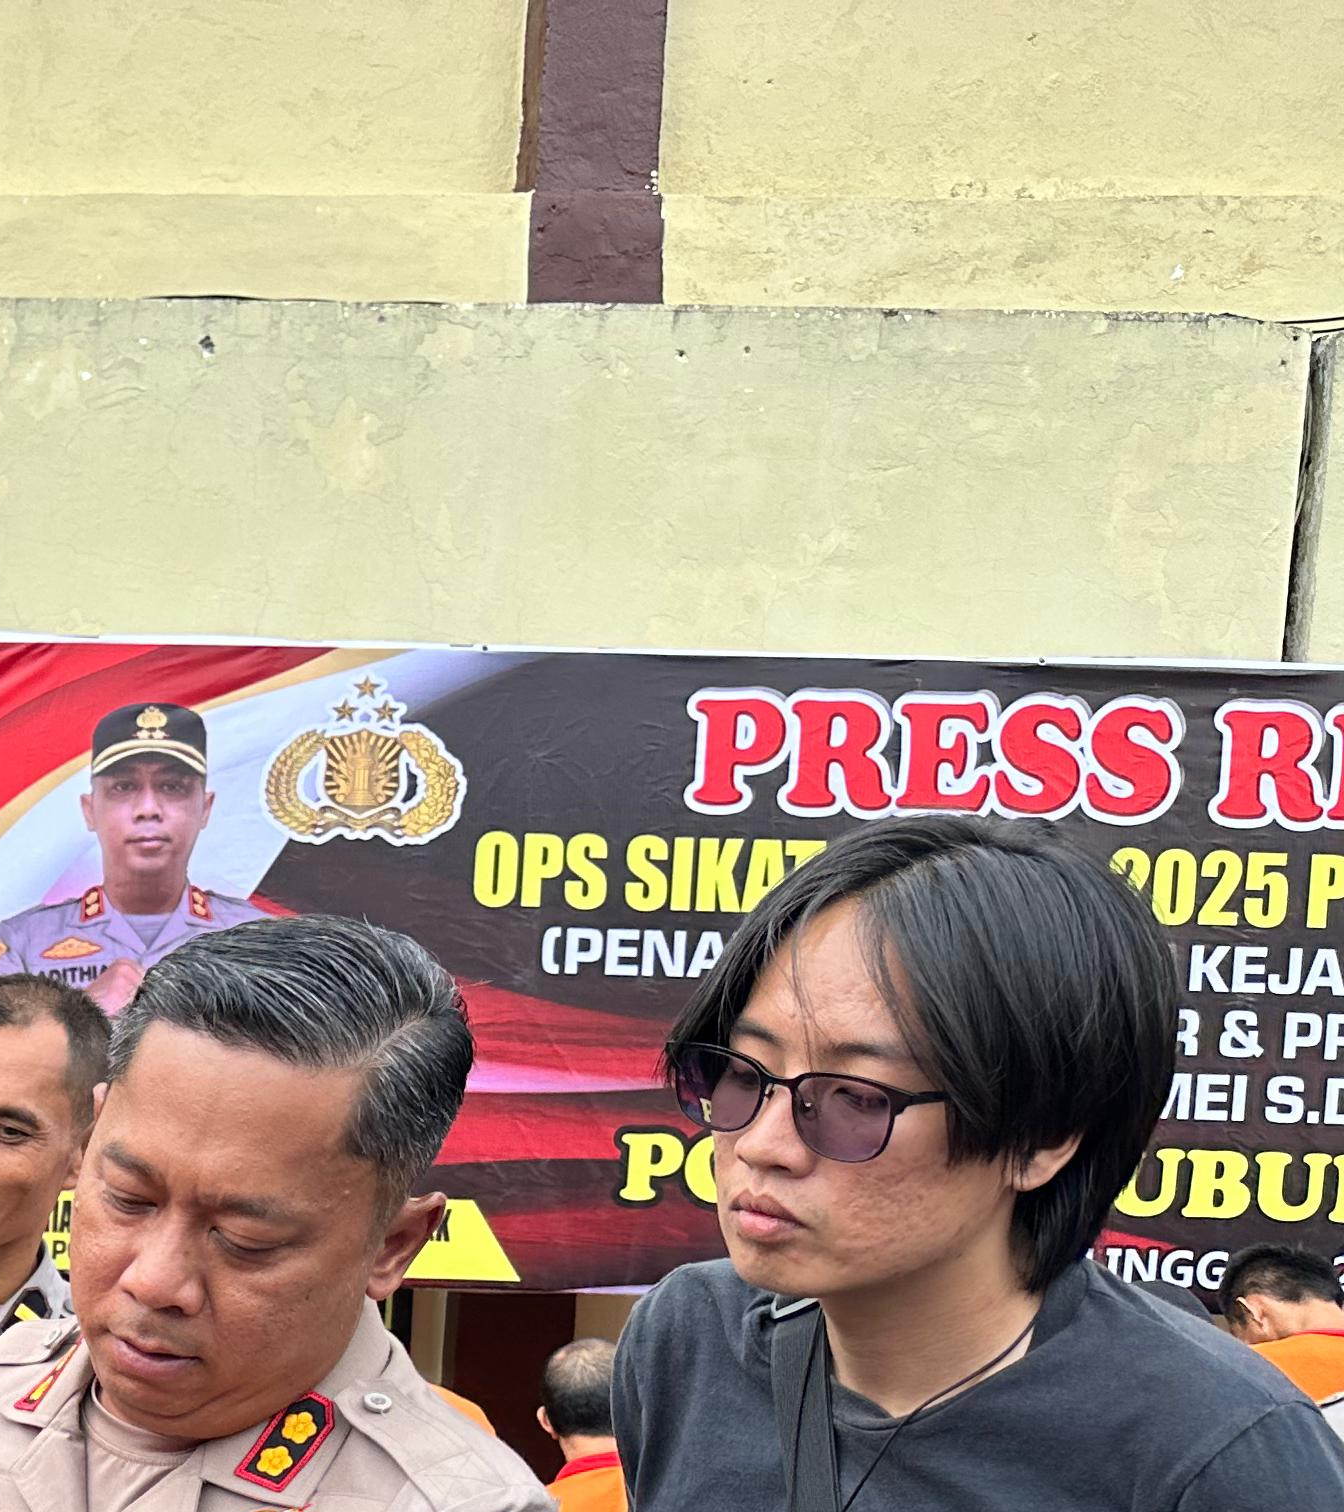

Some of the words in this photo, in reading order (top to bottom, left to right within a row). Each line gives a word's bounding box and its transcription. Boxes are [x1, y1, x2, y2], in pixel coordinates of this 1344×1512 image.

[686, 690, 1180, 825] PRESS
[1212, 702, 1344, 828] R
[473, 831, 608, 910] OPS
[1219, 1010, 1264, 1058] &
